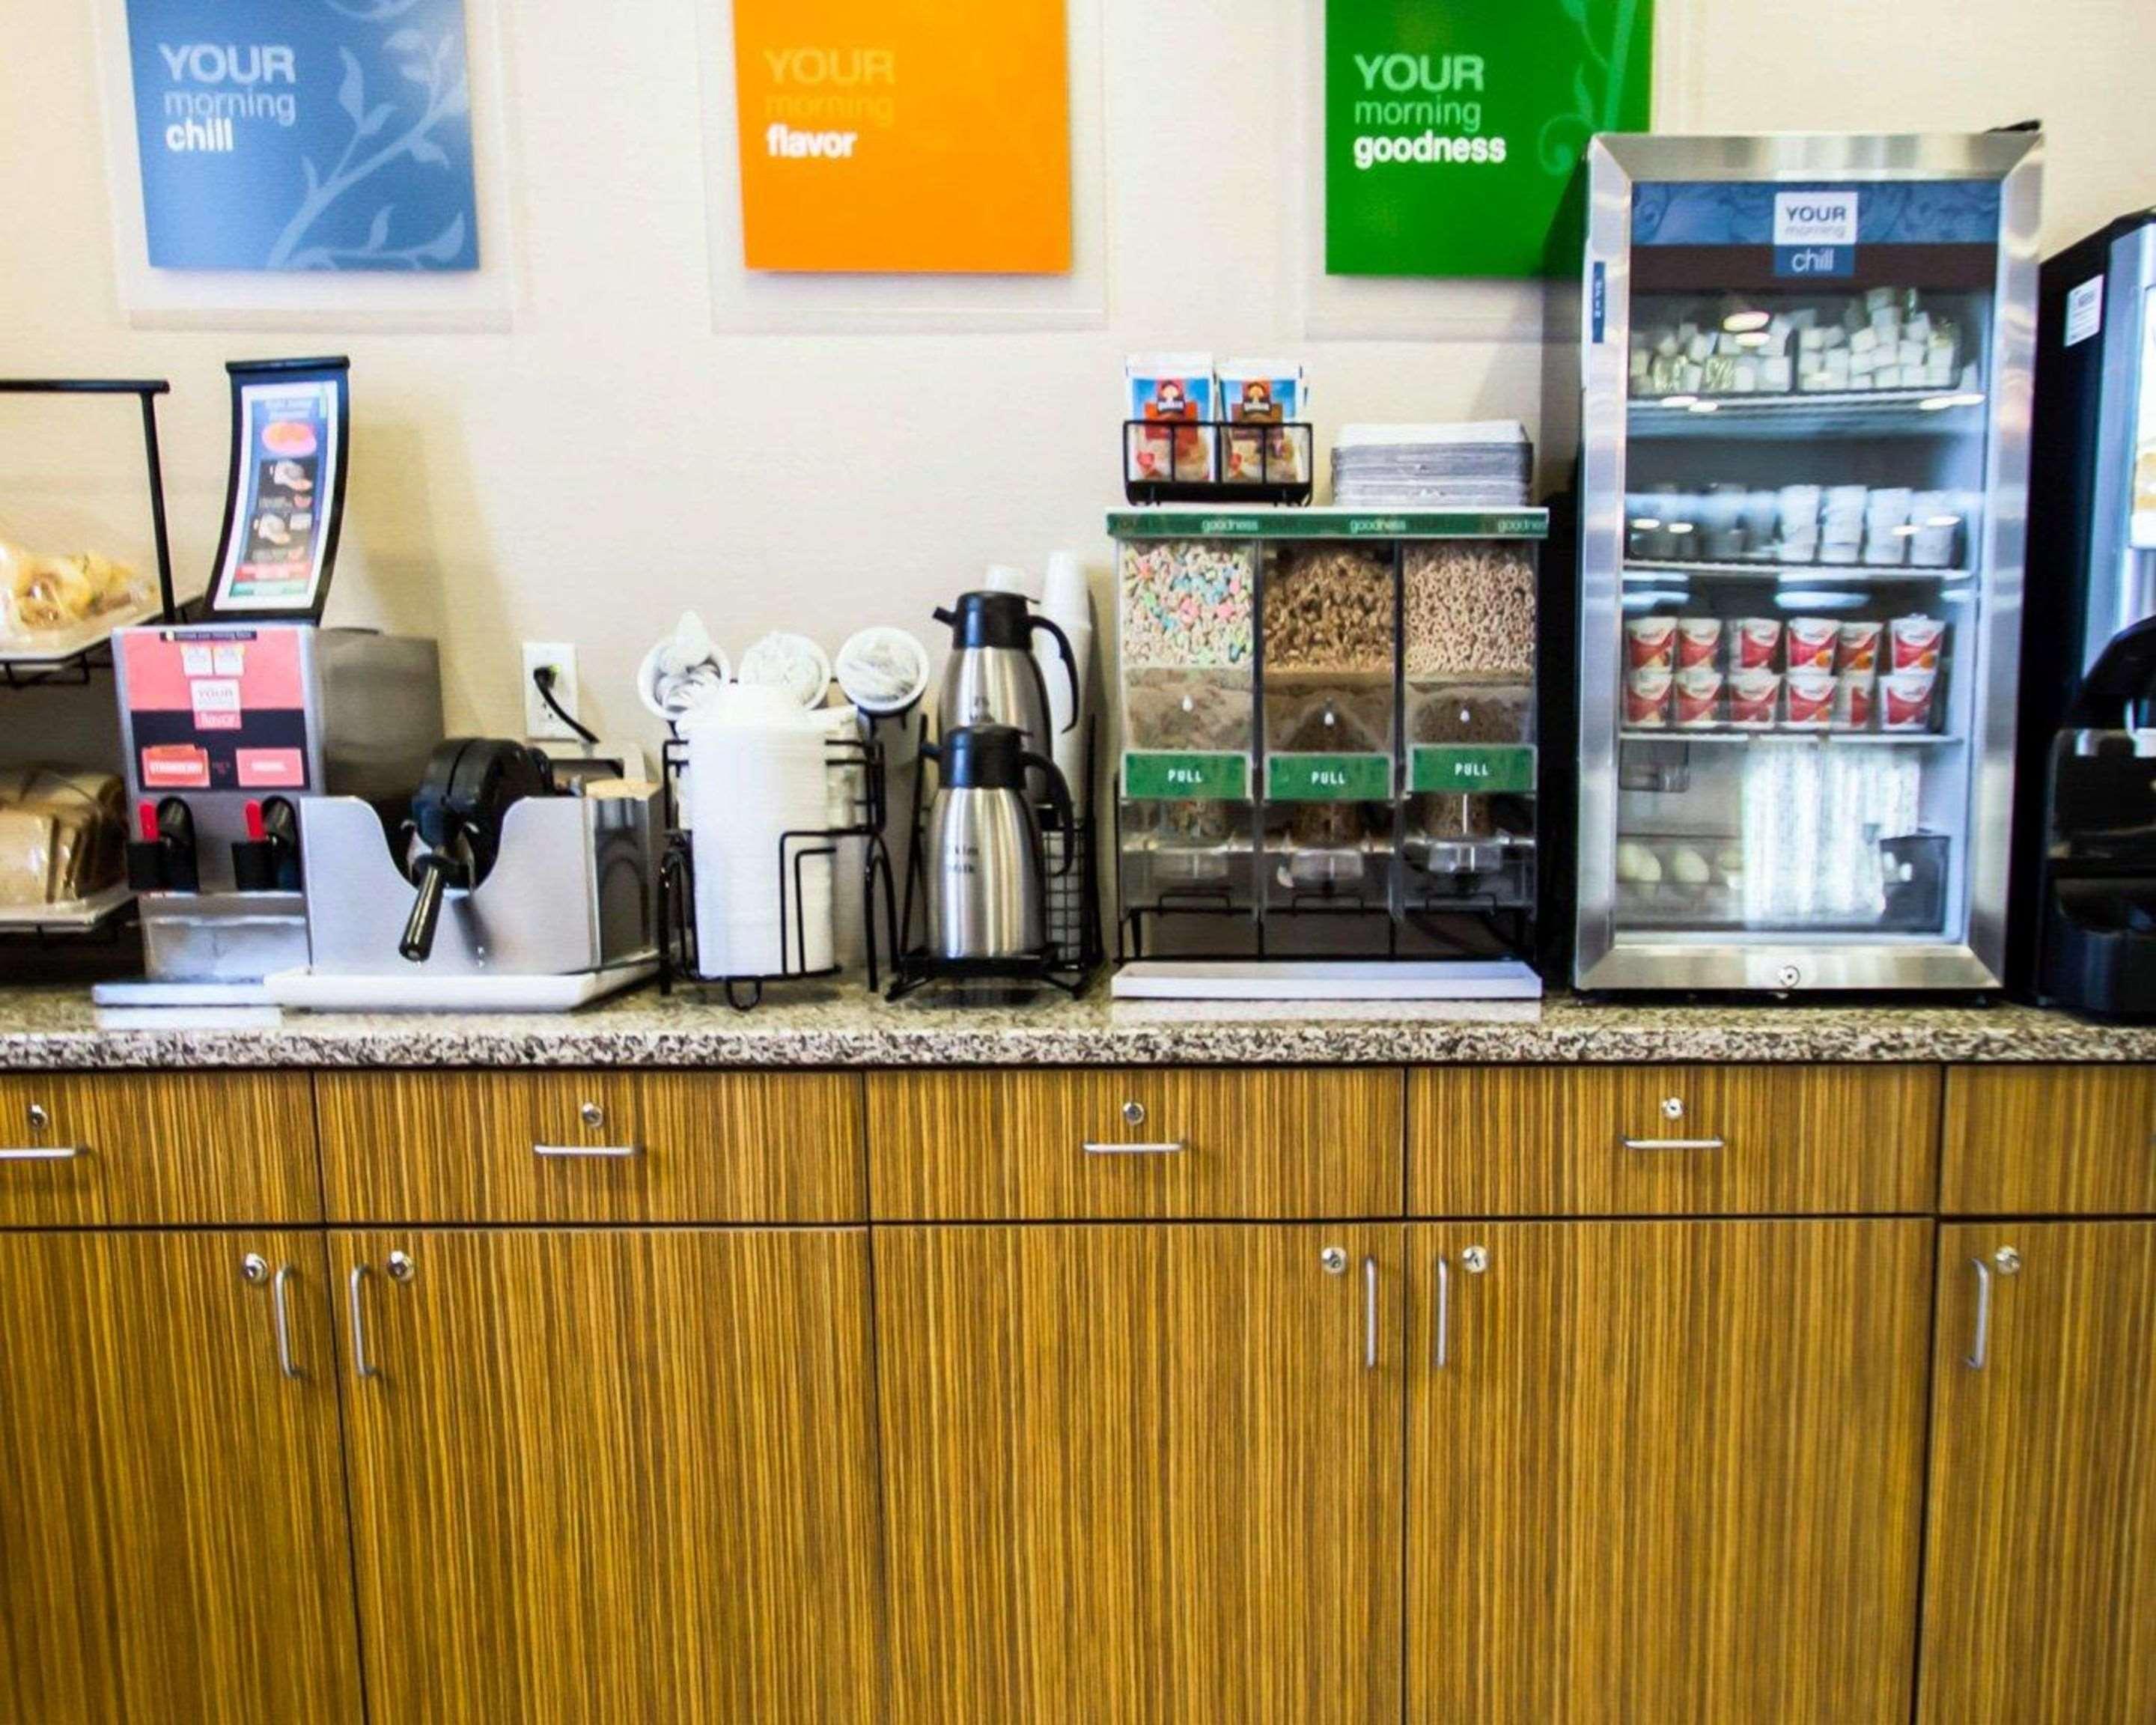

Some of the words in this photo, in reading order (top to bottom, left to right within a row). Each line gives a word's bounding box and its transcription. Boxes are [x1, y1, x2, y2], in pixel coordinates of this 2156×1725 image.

[156, 43, 296, 83] YOUR
[764, 48, 895, 85] YOUR
[1353, 53, 1484, 91] YOUR
[163, 85, 296, 127] morning
[764, 92, 895, 130] morning
[1354, 94, 1482, 133] morning
[165, 117, 234, 152] chill
[767, 123, 858, 159] flavor
[1353, 129, 1506, 170] goodness
[1786, 206, 1846, 222] YOUR
[1791, 247, 1834, 273] chill
[1202, 519, 1259, 534] goodness
[1350, 518, 1406, 535] goodness
[1168, 769, 1203, 784] PULL
[1311, 771, 1345, 786] PULL
[1455, 762, 1488, 777] PULL
